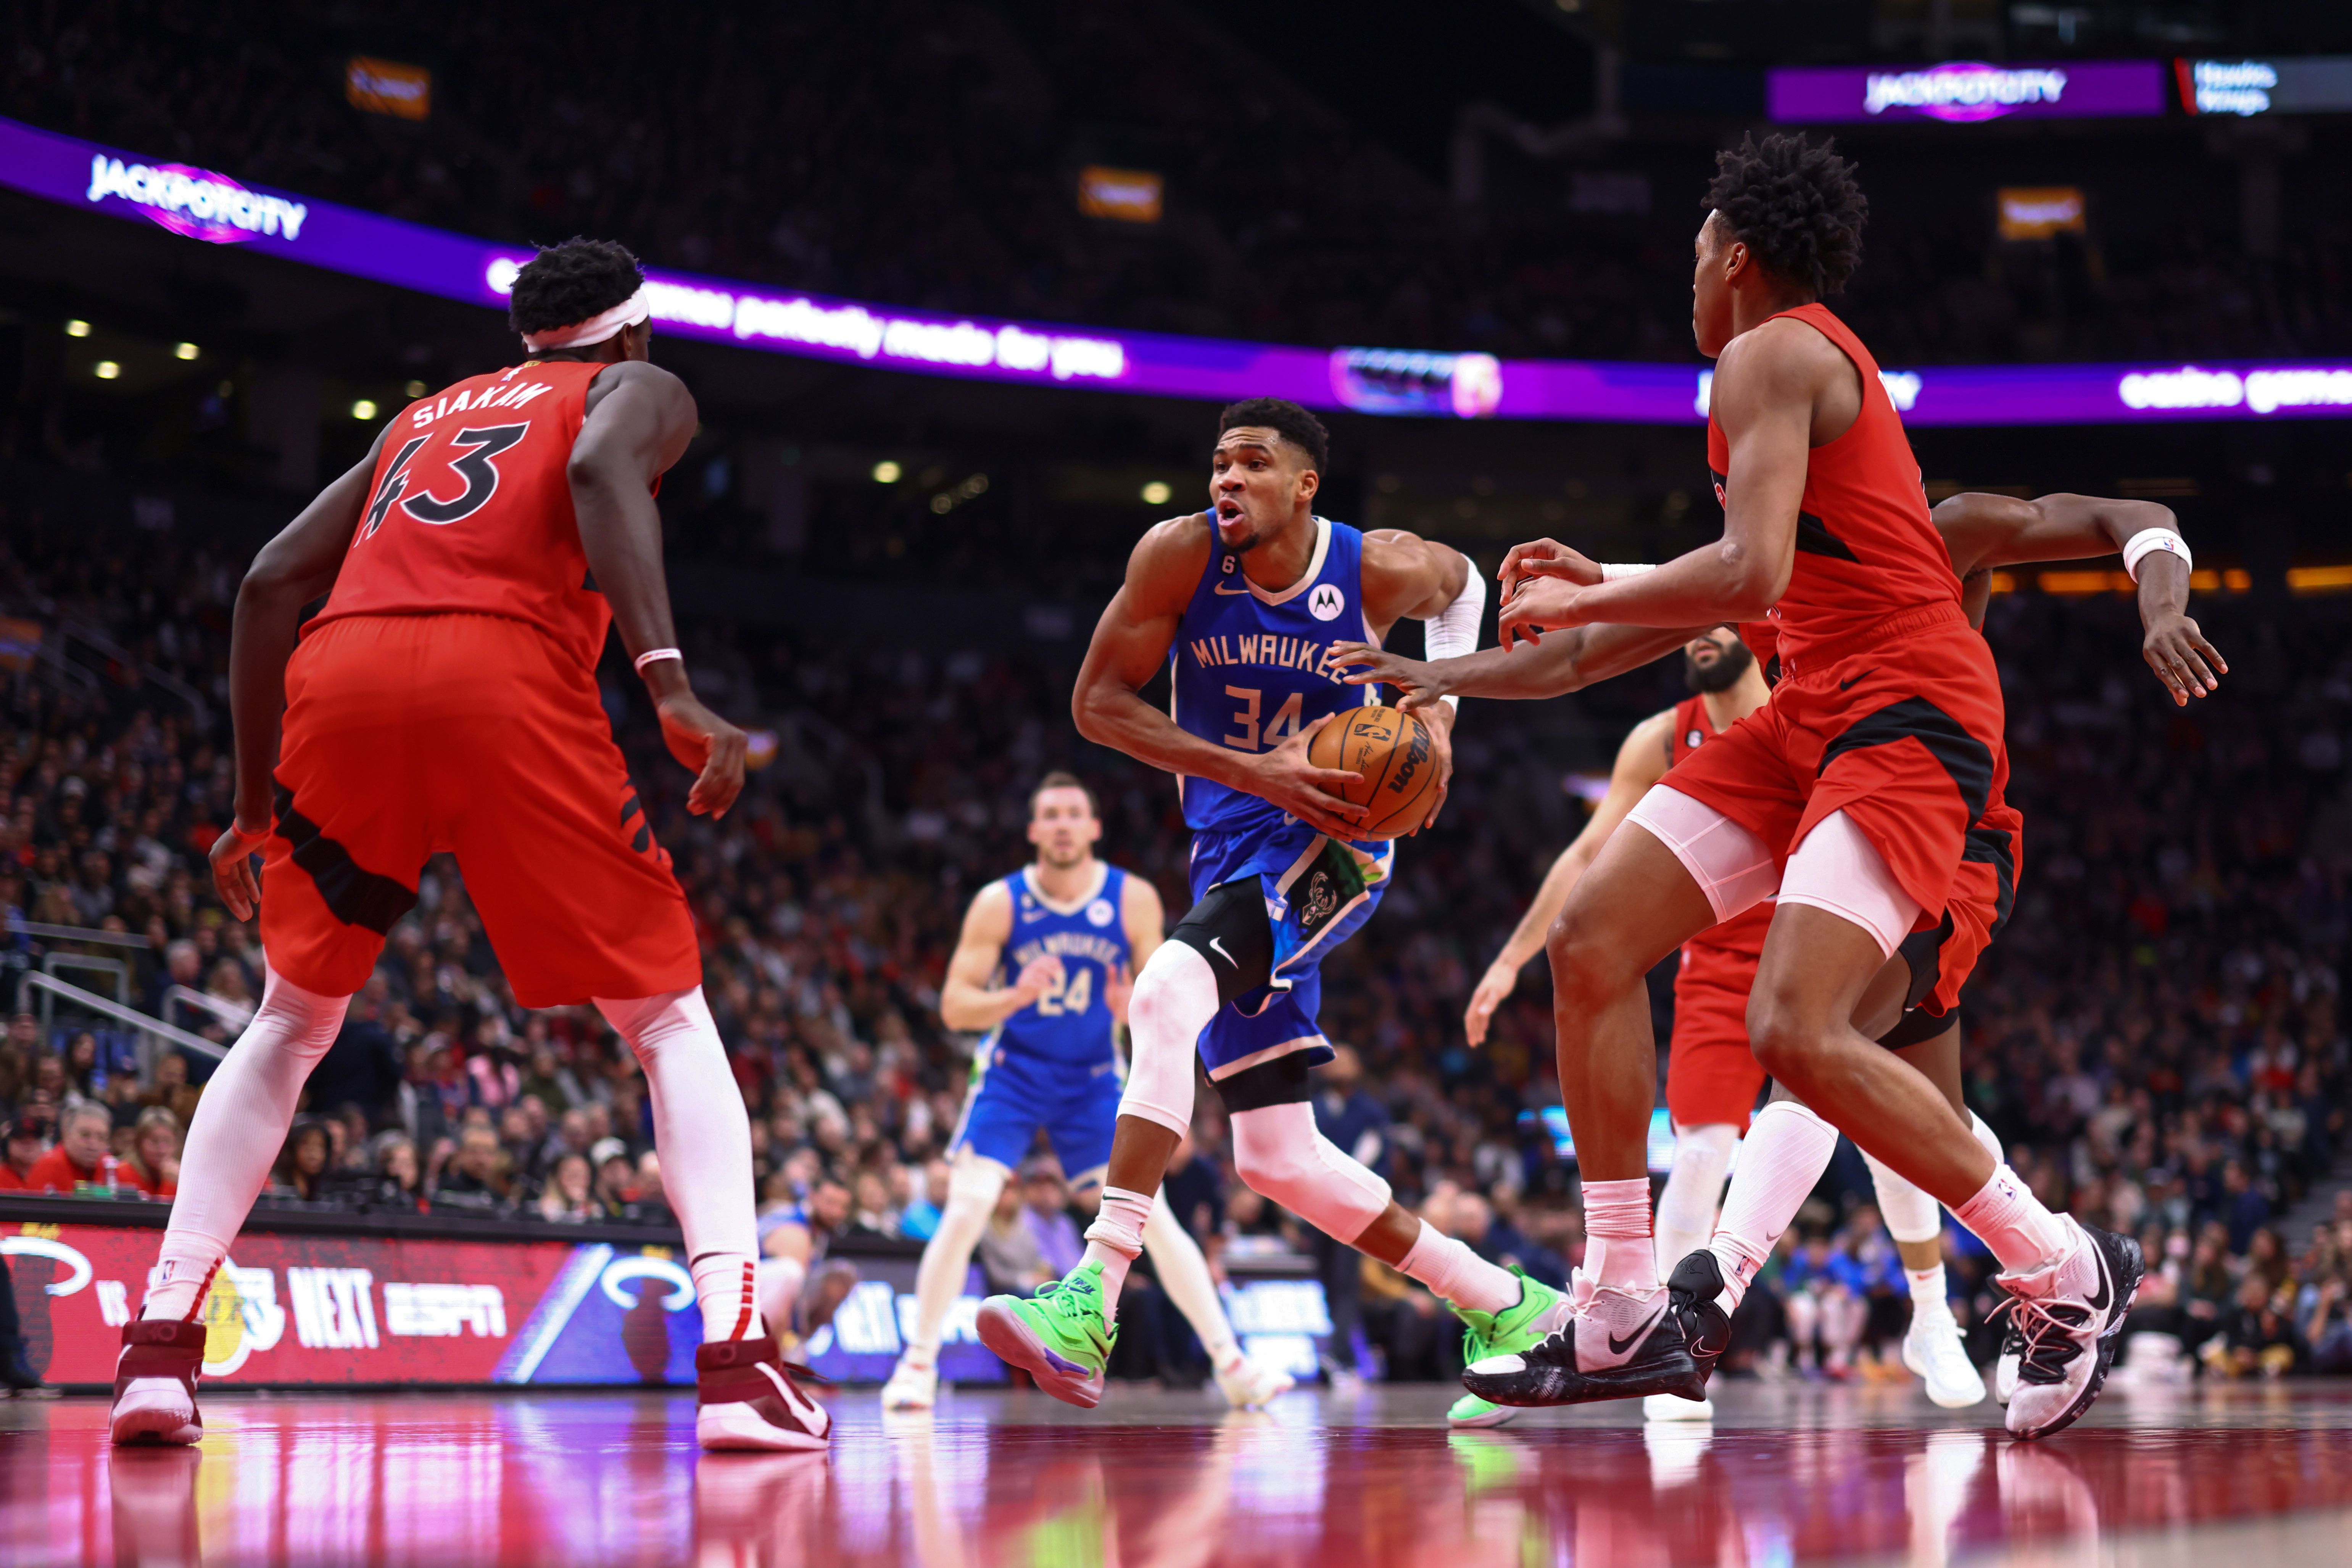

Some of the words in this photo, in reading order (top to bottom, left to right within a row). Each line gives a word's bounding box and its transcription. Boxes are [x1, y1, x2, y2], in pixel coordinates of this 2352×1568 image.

[1864, 69, 2066, 113] JACKPOTCITY
[86, 153, 307, 240] JACKPOTCITY
[414, 382, 553, 429] SIAKAM
[353, 420, 531, 548] 43
[1221, 554, 1237, 574] 6
[1224, 684, 1303, 752] 34
[1036, 966, 1093, 1016] 24
[287, 1267, 380, 1349] NEXT
[383, 1282, 507, 1338] ESPN
